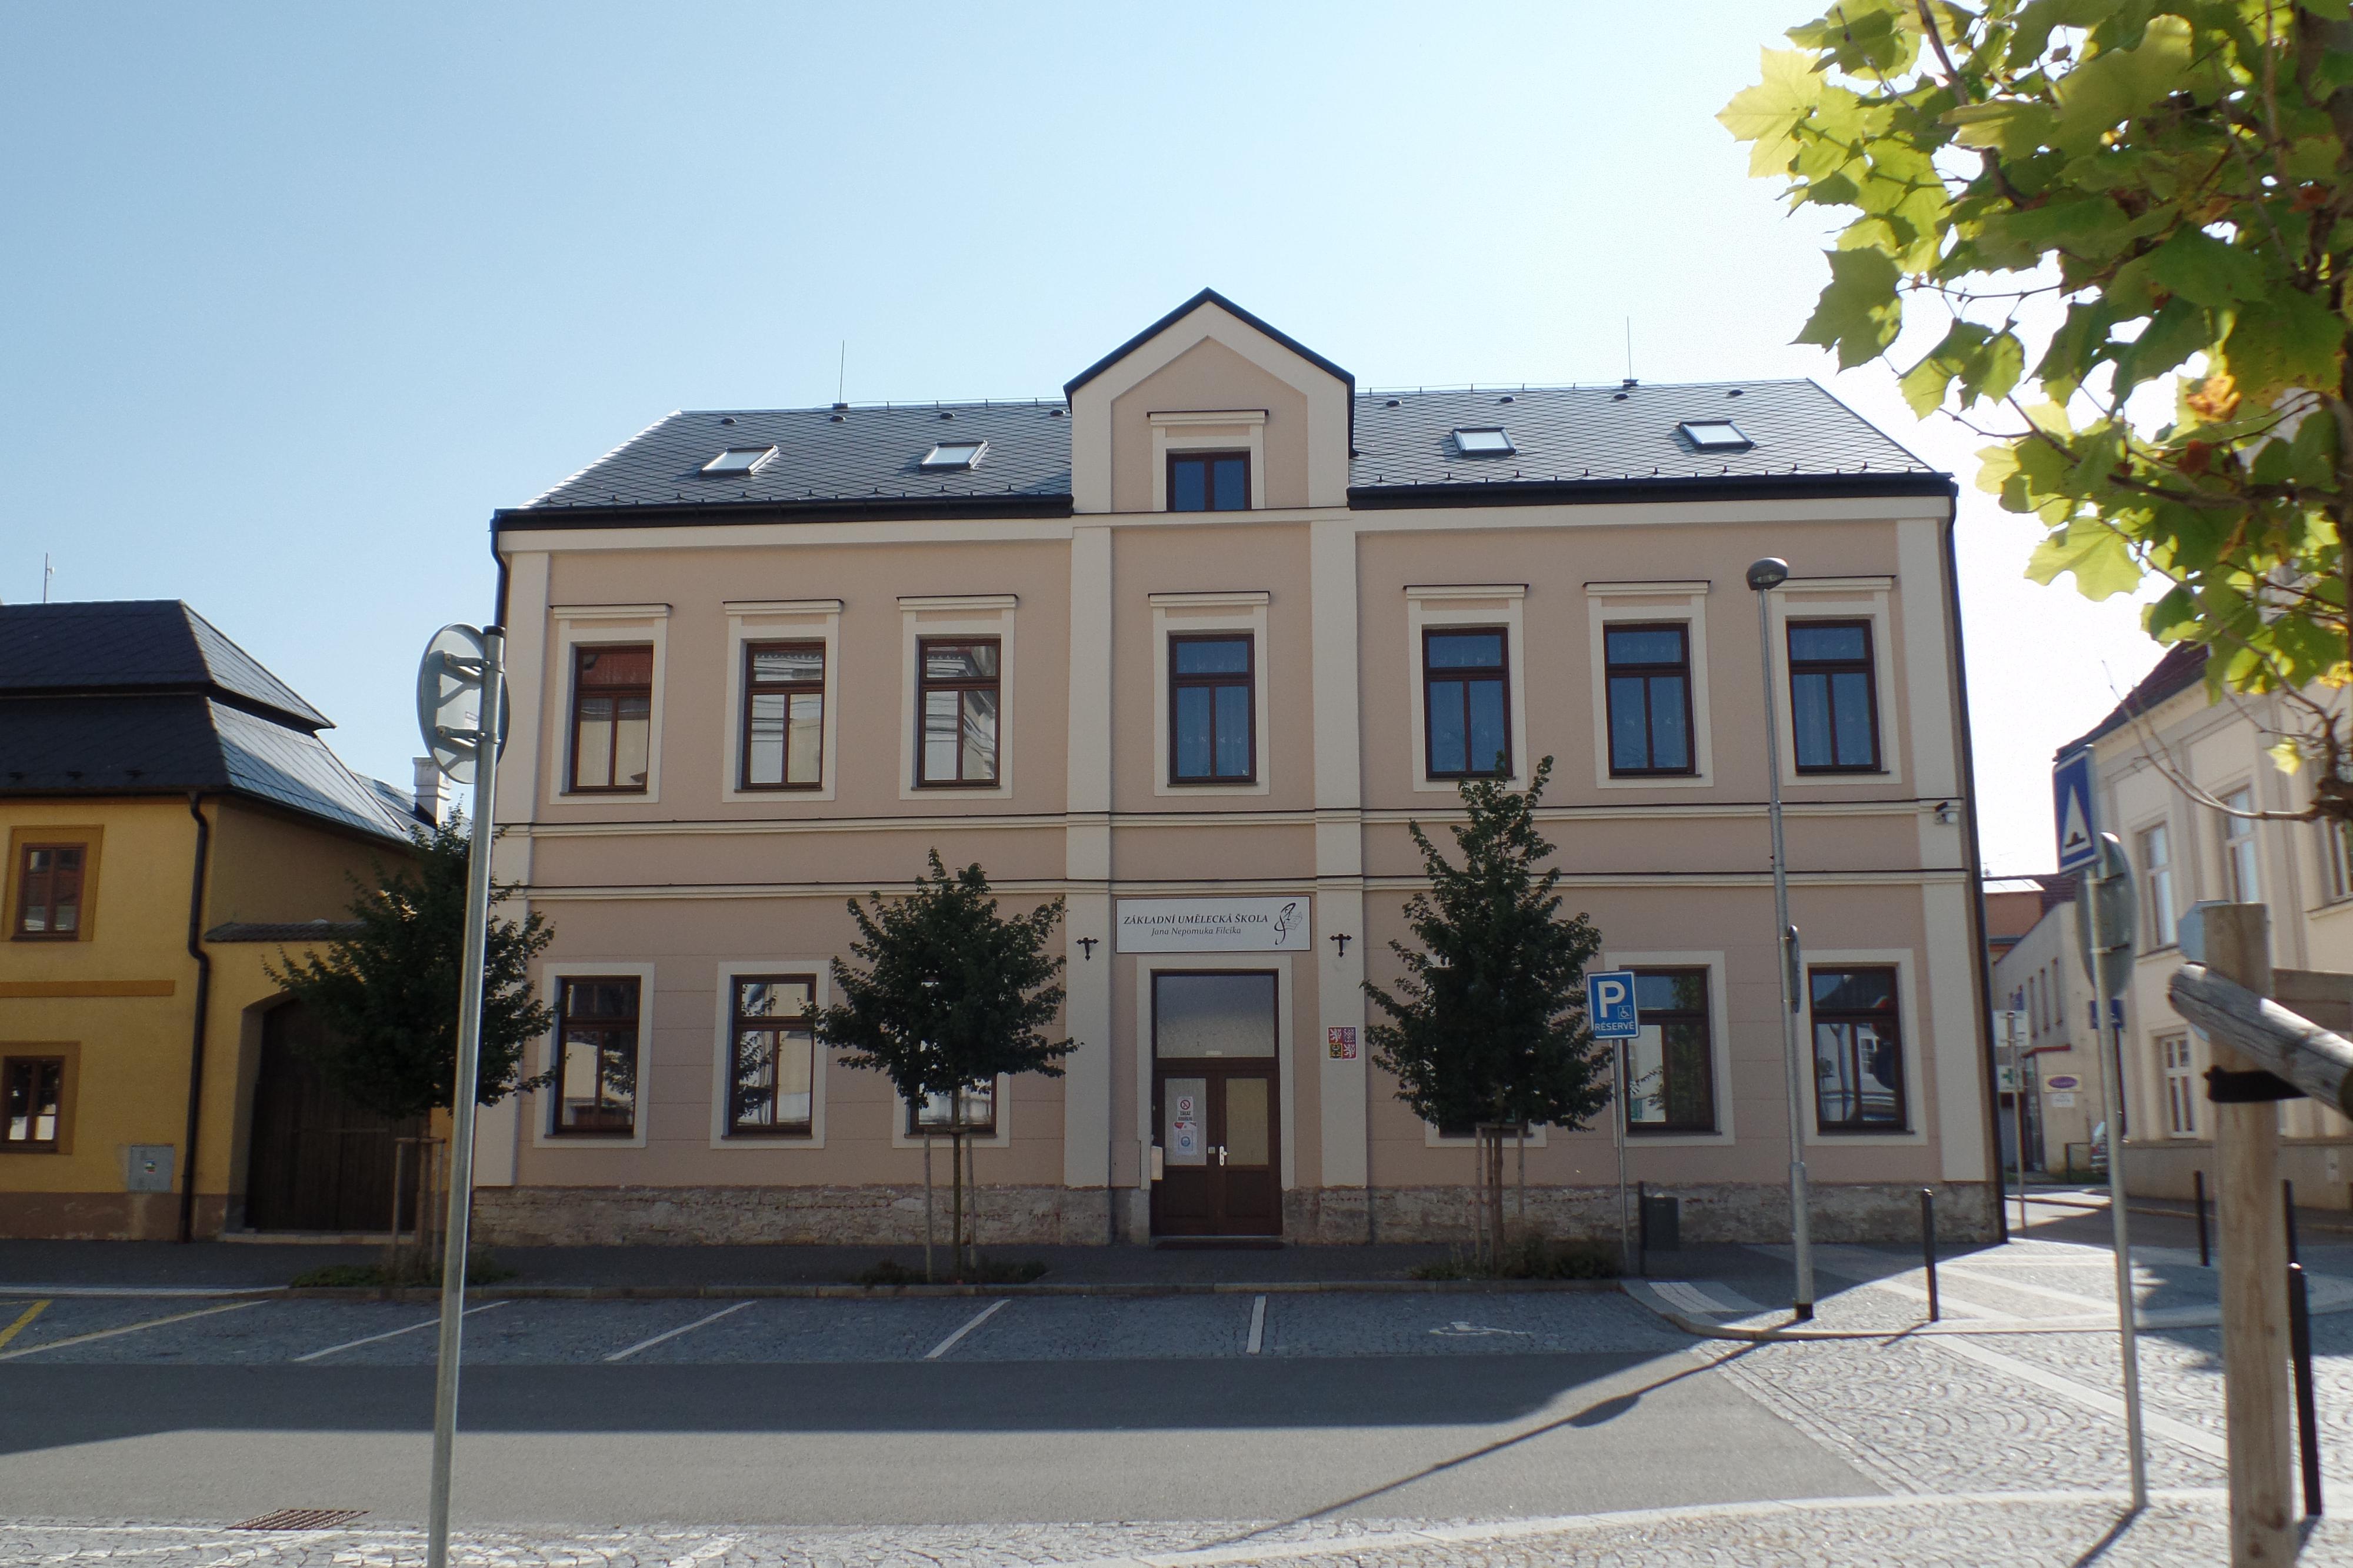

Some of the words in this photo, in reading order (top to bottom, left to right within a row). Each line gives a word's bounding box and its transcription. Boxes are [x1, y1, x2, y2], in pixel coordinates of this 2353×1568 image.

[1124, 914, 1175, 925] ZÁKLADNÍ
[1178, 913, 1232, 924] UMĚLECKÁ
[1235, 913, 1268, 923] ŠKOLA
[1151, 928, 1169, 937] Jana
[1171, 927, 1213, 936] Nepomuka
[1598, 980, 1625, 1018] P
[1595, 1020, 1635, 1031] RÉSERVÉ
